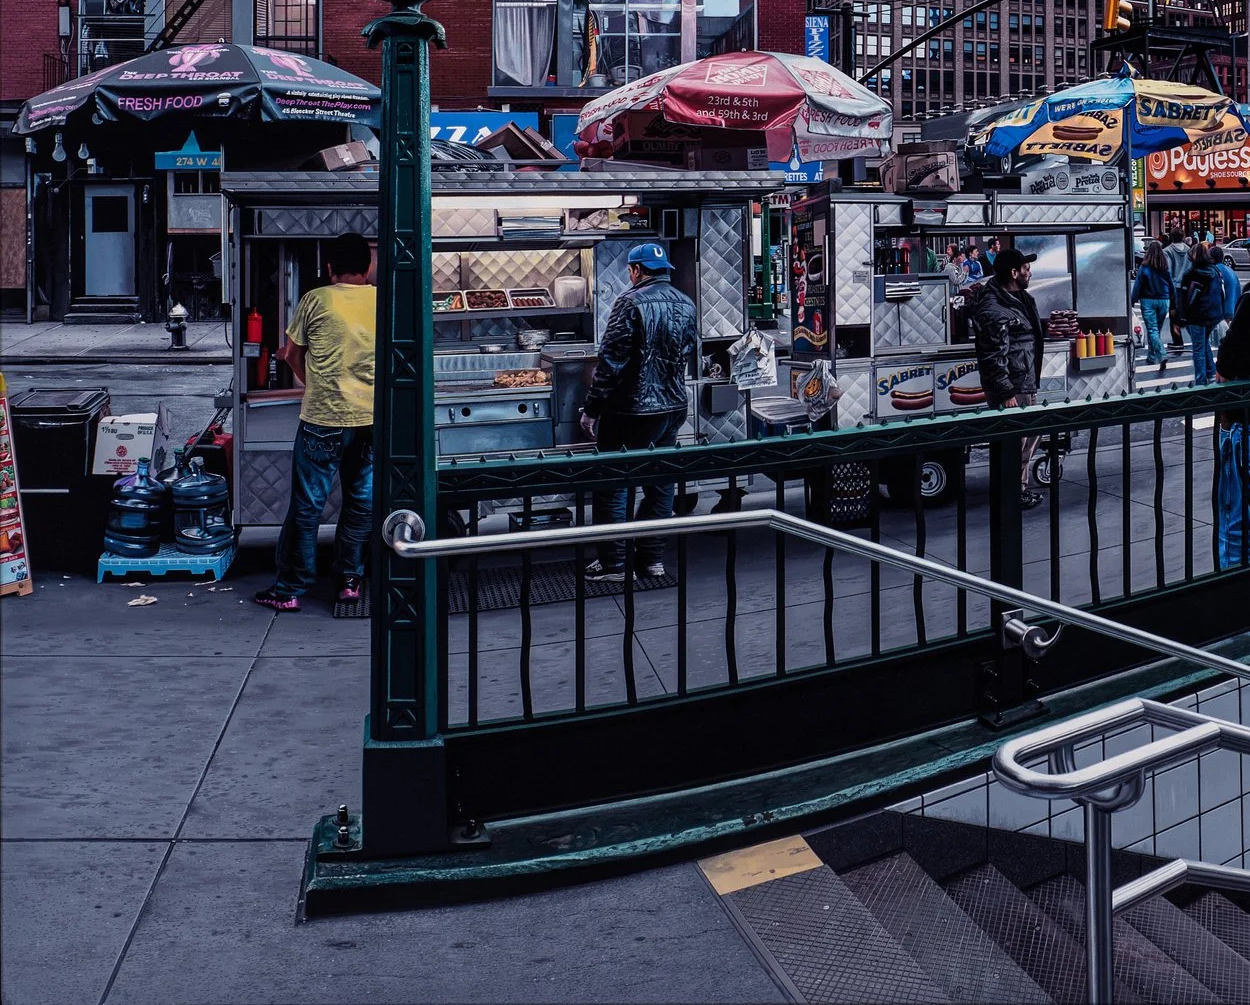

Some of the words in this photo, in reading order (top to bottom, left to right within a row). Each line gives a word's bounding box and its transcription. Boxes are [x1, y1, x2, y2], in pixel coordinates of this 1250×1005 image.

[806, 17, 828, 27] SIENA
[118, 97, 162, 111] FRESH
[165, 96, 202, 109] FOOD
[708, 96, 730, 106] 23rd
[732, 98, 741, 106] &
[742, 98, 759, 107] 5th
[718, 110, 740, 120] 59th
[742, 111, 750, 120] &
[752, 112, 768, 121] 3rd
[836, 114, 862, 128] FOOD
[176, 157, 194, 166] 274
[196, 158, 208, 166] W
